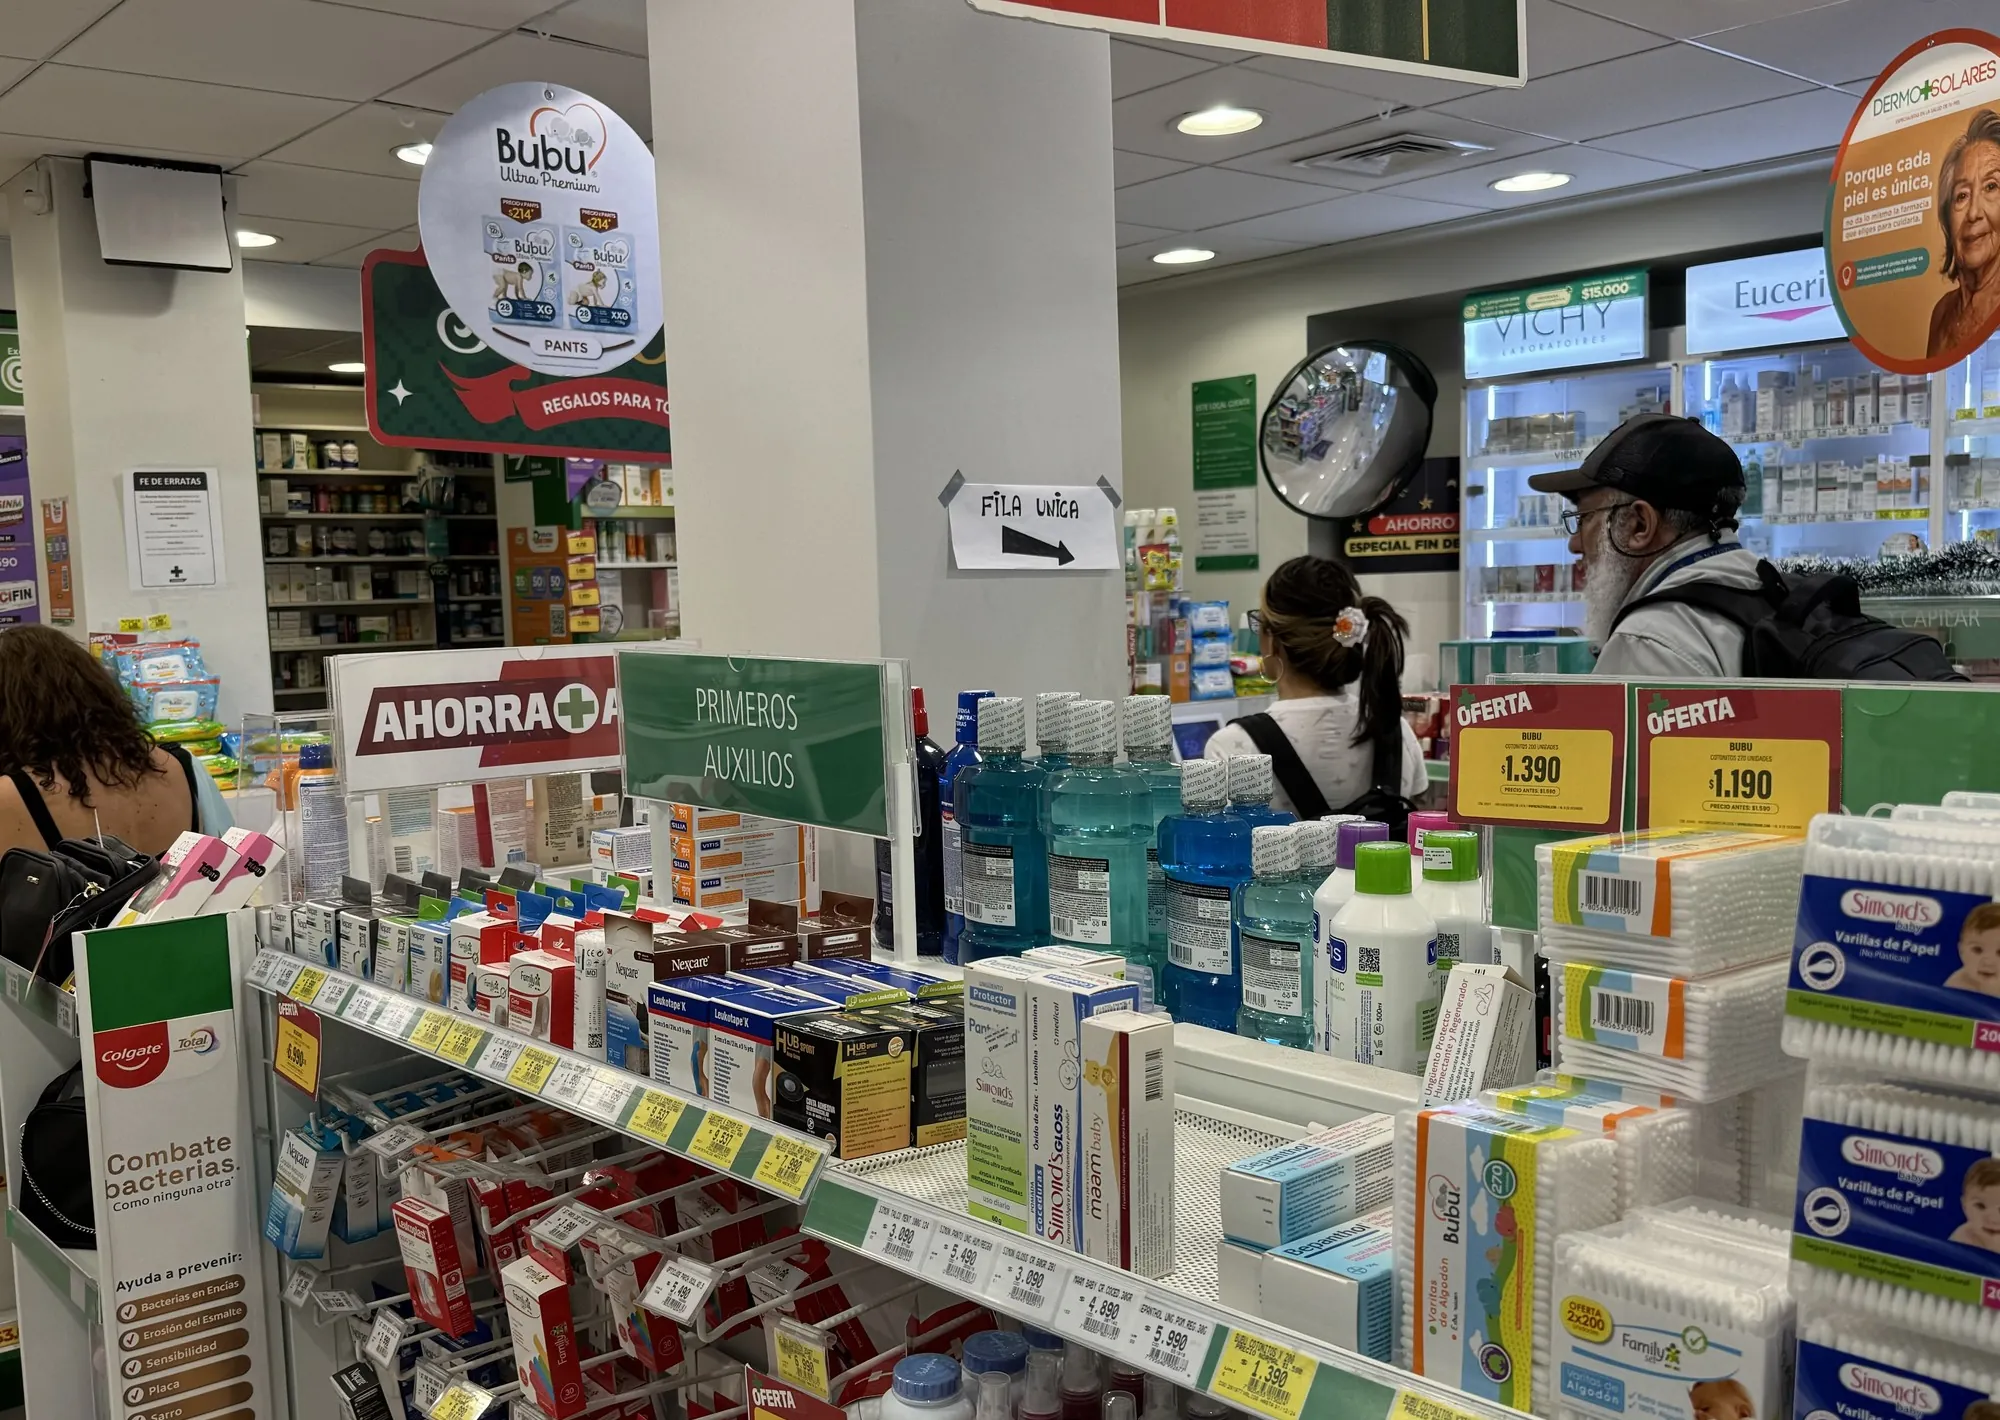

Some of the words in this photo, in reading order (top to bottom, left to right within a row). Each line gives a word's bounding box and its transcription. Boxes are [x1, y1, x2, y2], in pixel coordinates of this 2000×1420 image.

[497, 128, 586, 175] Bubu
[500, 165, 539, 186] Ultra
[540, 172, 600, 194] Premium
[1844, 162, 1893, 188] Porque
[1896, 150, 1931, 173] cada
[1843, 187, 1868, 212] piel
[1872, 185, 1887, 201] es
[1891, 174, 1933, 197] única,
[1845, 219, 1854, 227] no
[1871, 209, 1893, 221] mismo
[1893, 207, 1900, 216] la
[1900, 199, 1930, 215] farmacia
[1845, 230, 1857, 240] que
[1858, 225, 1877, 237] eliges
[1877, 220, 1892, 233] para
[494, 253, 516, 264] Pants
[515, 240, 548, 256] Bubu
[593, 249, 623, 264] Bubu
[575, 262, 594, 271] Pants
[1581, 282, 1629, 301] $15.000
[500, 302, 511, 312] 28
[536, 304, 553, 316] XG
[579, 310, 590, 318] 28
[611, 311, 629, 321] XXG
[1494, 301, 1612, 342] VICHY
[544, 339, 588, 354] PANTS
[1502, 336, 1607, 357] LABORATOIRES
[542, 391, 611, 416] REGALOS
[614, 392, 652, 410] PARA
[1554, 449, 1583, 461] VICHY
[139, 477, 149, 486] FE
[151, 477, 162, 486] DE
[164, 477, 201, 486] ERRATAS
[1385, 516, 1456, 532] AHORRO
[1350, 540, 1411, 553] ESPECIAL
[1415, 539, 1438, 550] FIN
[372, 695, 554, 743] AHORRA
[695, 687, 799, 732] PRIMEROS
[1456, 691, 1533, 727] OFERTA
[1646, 697, 1736, 736] OFERTA
[1522, 732, 1542, 741] BUBU
[1729, 742, 1753, 752] BUBU
[703, 743, 795, 791] AUXILIOS
[1501, 755, 1561, 783] $1.390
[1747, 755, 1773, 763] UNIDADES
[1186, 765, 1217, 779] RECICLABLE
[1709, 768, 1772, 800] $1.190
[702, 841, 720, 849] VITIS
[702, 879, 720, 887] VITIS
[1850, 892, 1933, 923] Simond's
[1895, 920, 1925, 936] baby
[1835, 931, 1881, 950] Varillas
[1883, 938, 1900, 950] de
[1902, 940, 1941, 957] Papel
[616, 961, 639, 979] Nexcare
[671, 955, 710, 972] Nexcare
[653, 994, 681, 1011] Leukotape
[681, 1003, 686, 1012] K
[972, 988, 1012, 1006] Protector
[1449, 978, 1469, 1034] Regenerador
[278, 1002, 299, 1017] OFERTA
[714, 1008, 743, 1027] Leukotape
[744, 1017, 749, 1028] K
[101, 1043, 164, 1063] Colgate
[178, 1034, 208, 1049] Total
[776, 1029, 800, 1053] HUB
[800, 1043, 815, 1055] SPORT
[846, 1043, 866, 1057] HUB
[866, 1042, 878, 1050] SPORT
[1449, 1035, 1457, 1043] y
[1424, 1053, 1442, 1096] Ungüento
[1436, 1009, 1452, 1051] Protector
[1434, 1045, 1452, 1099] Humectante
[975, 1077, 1013, 1101] Simond's
[650, 1105, 669, 1121] 9.537
[1033, 1113, 1039, 1126] de
[712, 1129, 733, 1146] 9.537
[1054, 1103, 1064, 1153] GLOSS
[107, 1135, 232, 1176] Combate
[286, 1136, 310, 1169] Nexcare
[781, 1154, 803, 1173] 7.990
[1236, 1142, 1312, 1171] Bepanthol
[1852, 1139, 1935, 1176] Simond's
[104, 1158, 241, 1200] bacterias.
[1491, 1165, 1504, 1195] 270
[1897, 1170, 1927, 1187] baby
[113, 1197, 150, 1213] Como
[153, 1184, 204, 1204] ninguna
[982, 1195, 993, 1205] uso
[994, 1199, 1011, 1211] diario
[1036, 1168, 1044, 1233] Coceduras
[1047, 1152, 1064, 1245] Simond's
[1838, 1176, 1885, 1198] Varillas
[1886, 1184, 1904, 1200] de
[1905, 1189, 1944, 1209] Papel
[991, 1215, 1002, 1226] 60g
[1443, 1190, 1461, 1245] Bubu
[888, 1223, 915, 1244] 3.090
[1284, 1223, 1371, 1258] Bepanthol
[950, 1244, 978, 1266] 5.490
[115, 1272, 162, 1293] Ayuda
[166, 1269, 174, 1279] a
[178, 1252, 243, 1279] prevenir:
[1015, 1266, 1045, 1288] 3.090
[1439, 1257, 1449, 1312] Algodón
[141, 1293, 190, 1312] Bacterias
[192, 1289, 205, 1299] en
[207, 1280, 240, 1296] Encías
[669, 1280, 692, 1299] 5.490
[1428, 1280, 1438, 1323] Varitas
[1088, 1296, 1120, 1320] 4.890
[1569, 1301, 1602, 1318] OFERTA
[143, 1323, 183, 1341] Erosión
[184, 1317, 201, 1329] del
[202, 1306, 243, 1324] Esmalte
[1440, 1315, 1448, 1328] de
[1566, 1310, 1605, 1331] 2x200
[557, 1335, 567, 1366] Family
[663, 1339, 672, 1349] 30
[1153, 1325, 1188, 1352] 5.990
[1234, 1333, 1247, 1346] BUBU
[1248, 1337, 1278, 1358] COTONITOS
[1234, 1343, 1257, 1358] PRECIO
[1622, 1333, 1665, 1362] Family
[146, 1341, 218, 1369] Sensibilidad
[1251, 1359, 1289, 1388] 1.390
[1566, 1368, 1601, 1388] Varitas
[1603, 1380, 1619, 1392] de
[148, 1380, 181, 1397] Placa
[564, 1386, 575, 1397] 30
[752, 1388, 797, 1409] OFERTA
[1566, 1380, 1620, 1406] Algodón
[1850, 1367, 1933, 1410] Simond's
[1896, 1402, 1924, 1420] baby
